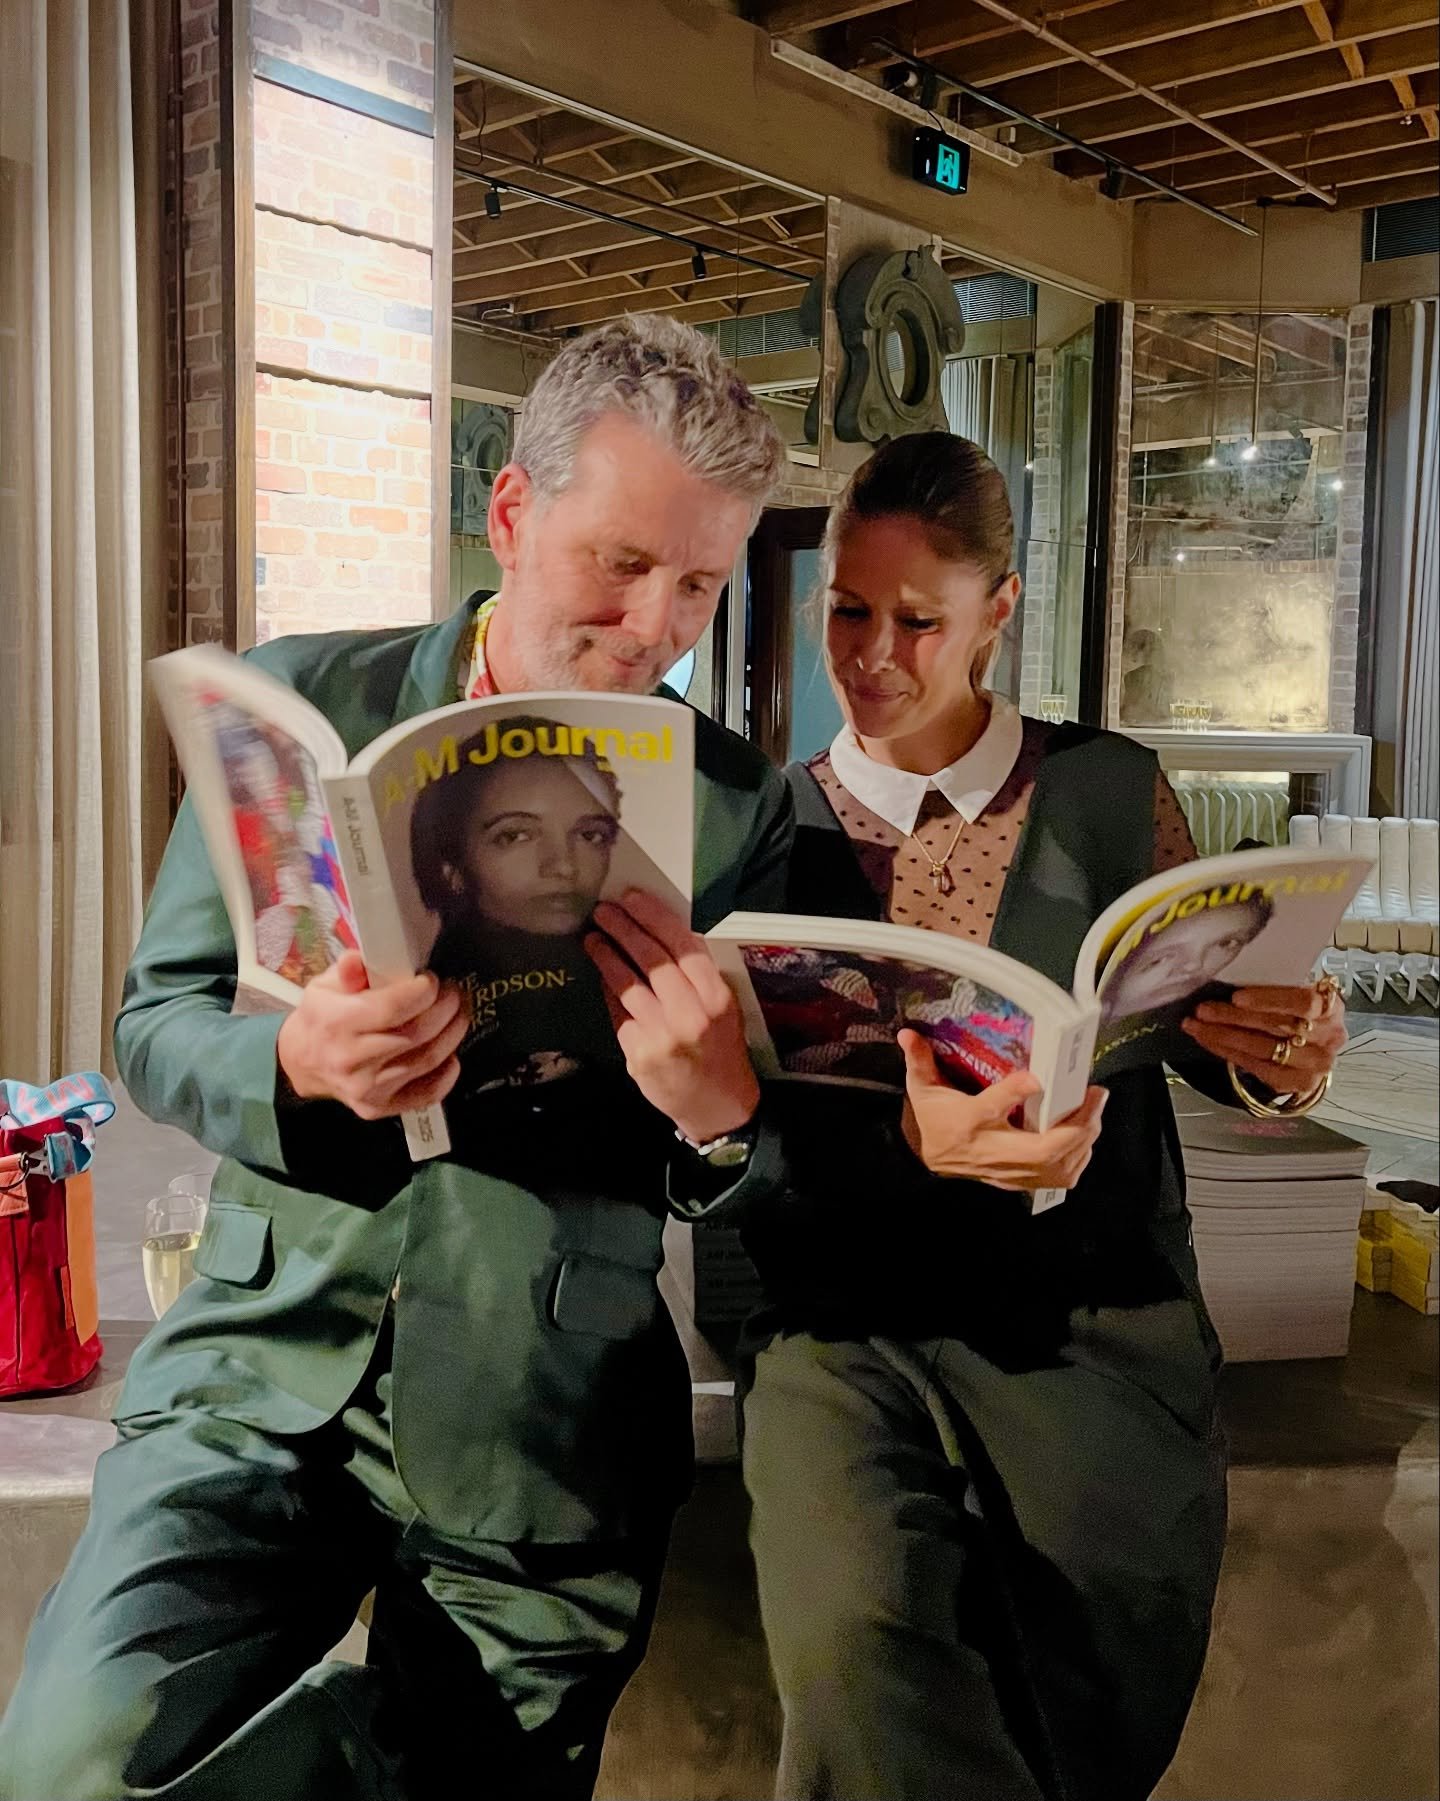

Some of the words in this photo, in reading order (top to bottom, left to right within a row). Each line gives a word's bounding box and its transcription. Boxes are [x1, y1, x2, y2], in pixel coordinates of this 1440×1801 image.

[468, 722, 673, 765] Journal
[1149, 871, 1349, 934] Journal
[476, 969, 575, 1008] RDSON-
